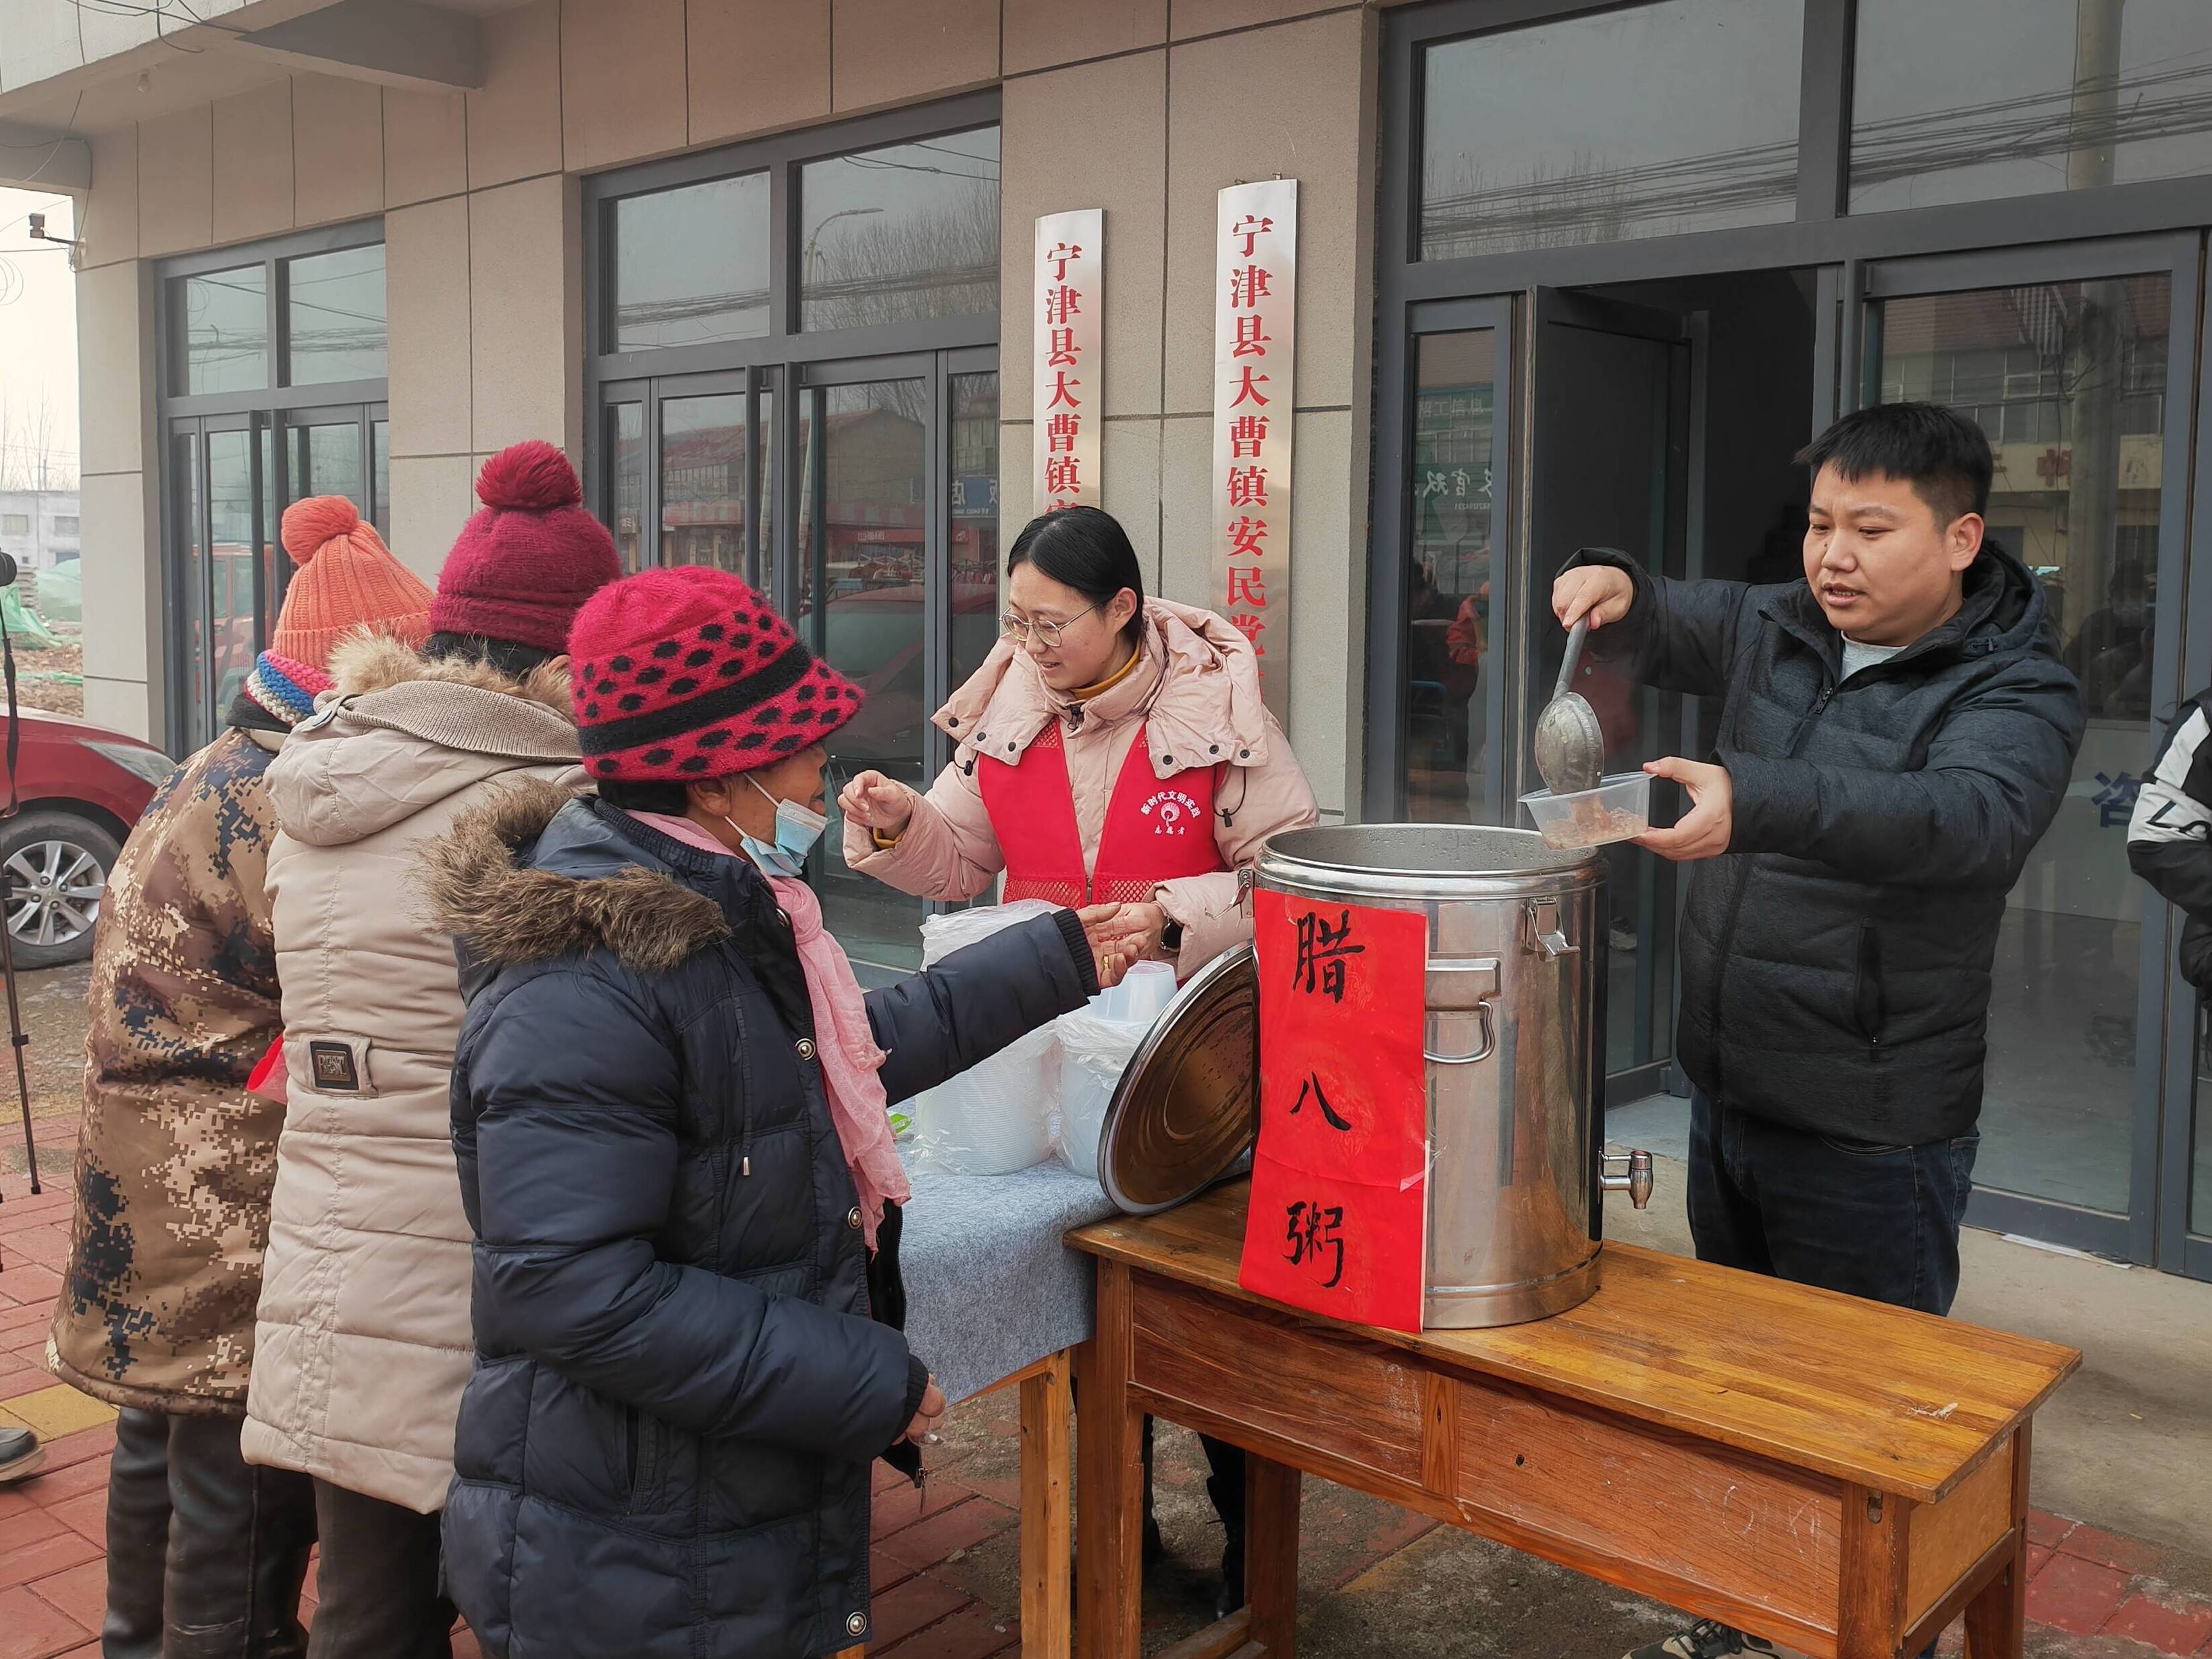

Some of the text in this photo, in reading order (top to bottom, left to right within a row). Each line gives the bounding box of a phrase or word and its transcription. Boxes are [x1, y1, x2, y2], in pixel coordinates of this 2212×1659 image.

[1045, 242, 1082, 513] 宁津县大曹镇
[1226, 215, 1273, 679] 宁津县大曹镇安民党
[1282, 909, 1365, 1288] 腊八粥
